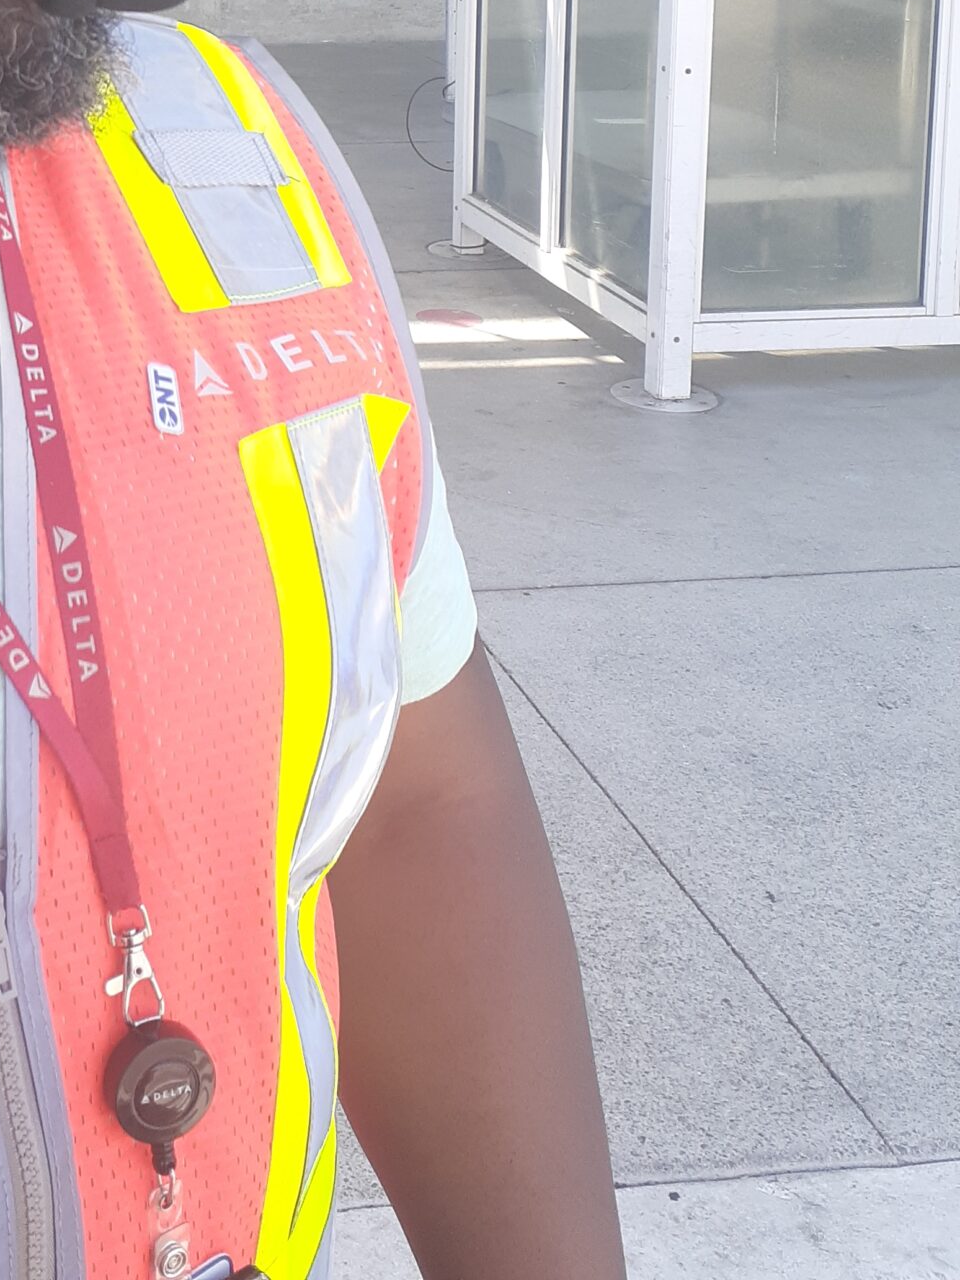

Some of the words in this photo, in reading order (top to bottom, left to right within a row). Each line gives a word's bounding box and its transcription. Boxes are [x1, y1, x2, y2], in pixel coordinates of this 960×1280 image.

[21, 343, 57, 444] DELTA
[62, 561, 99, 682] DELTA
[153, 1084, 192, 1102] DELTA
